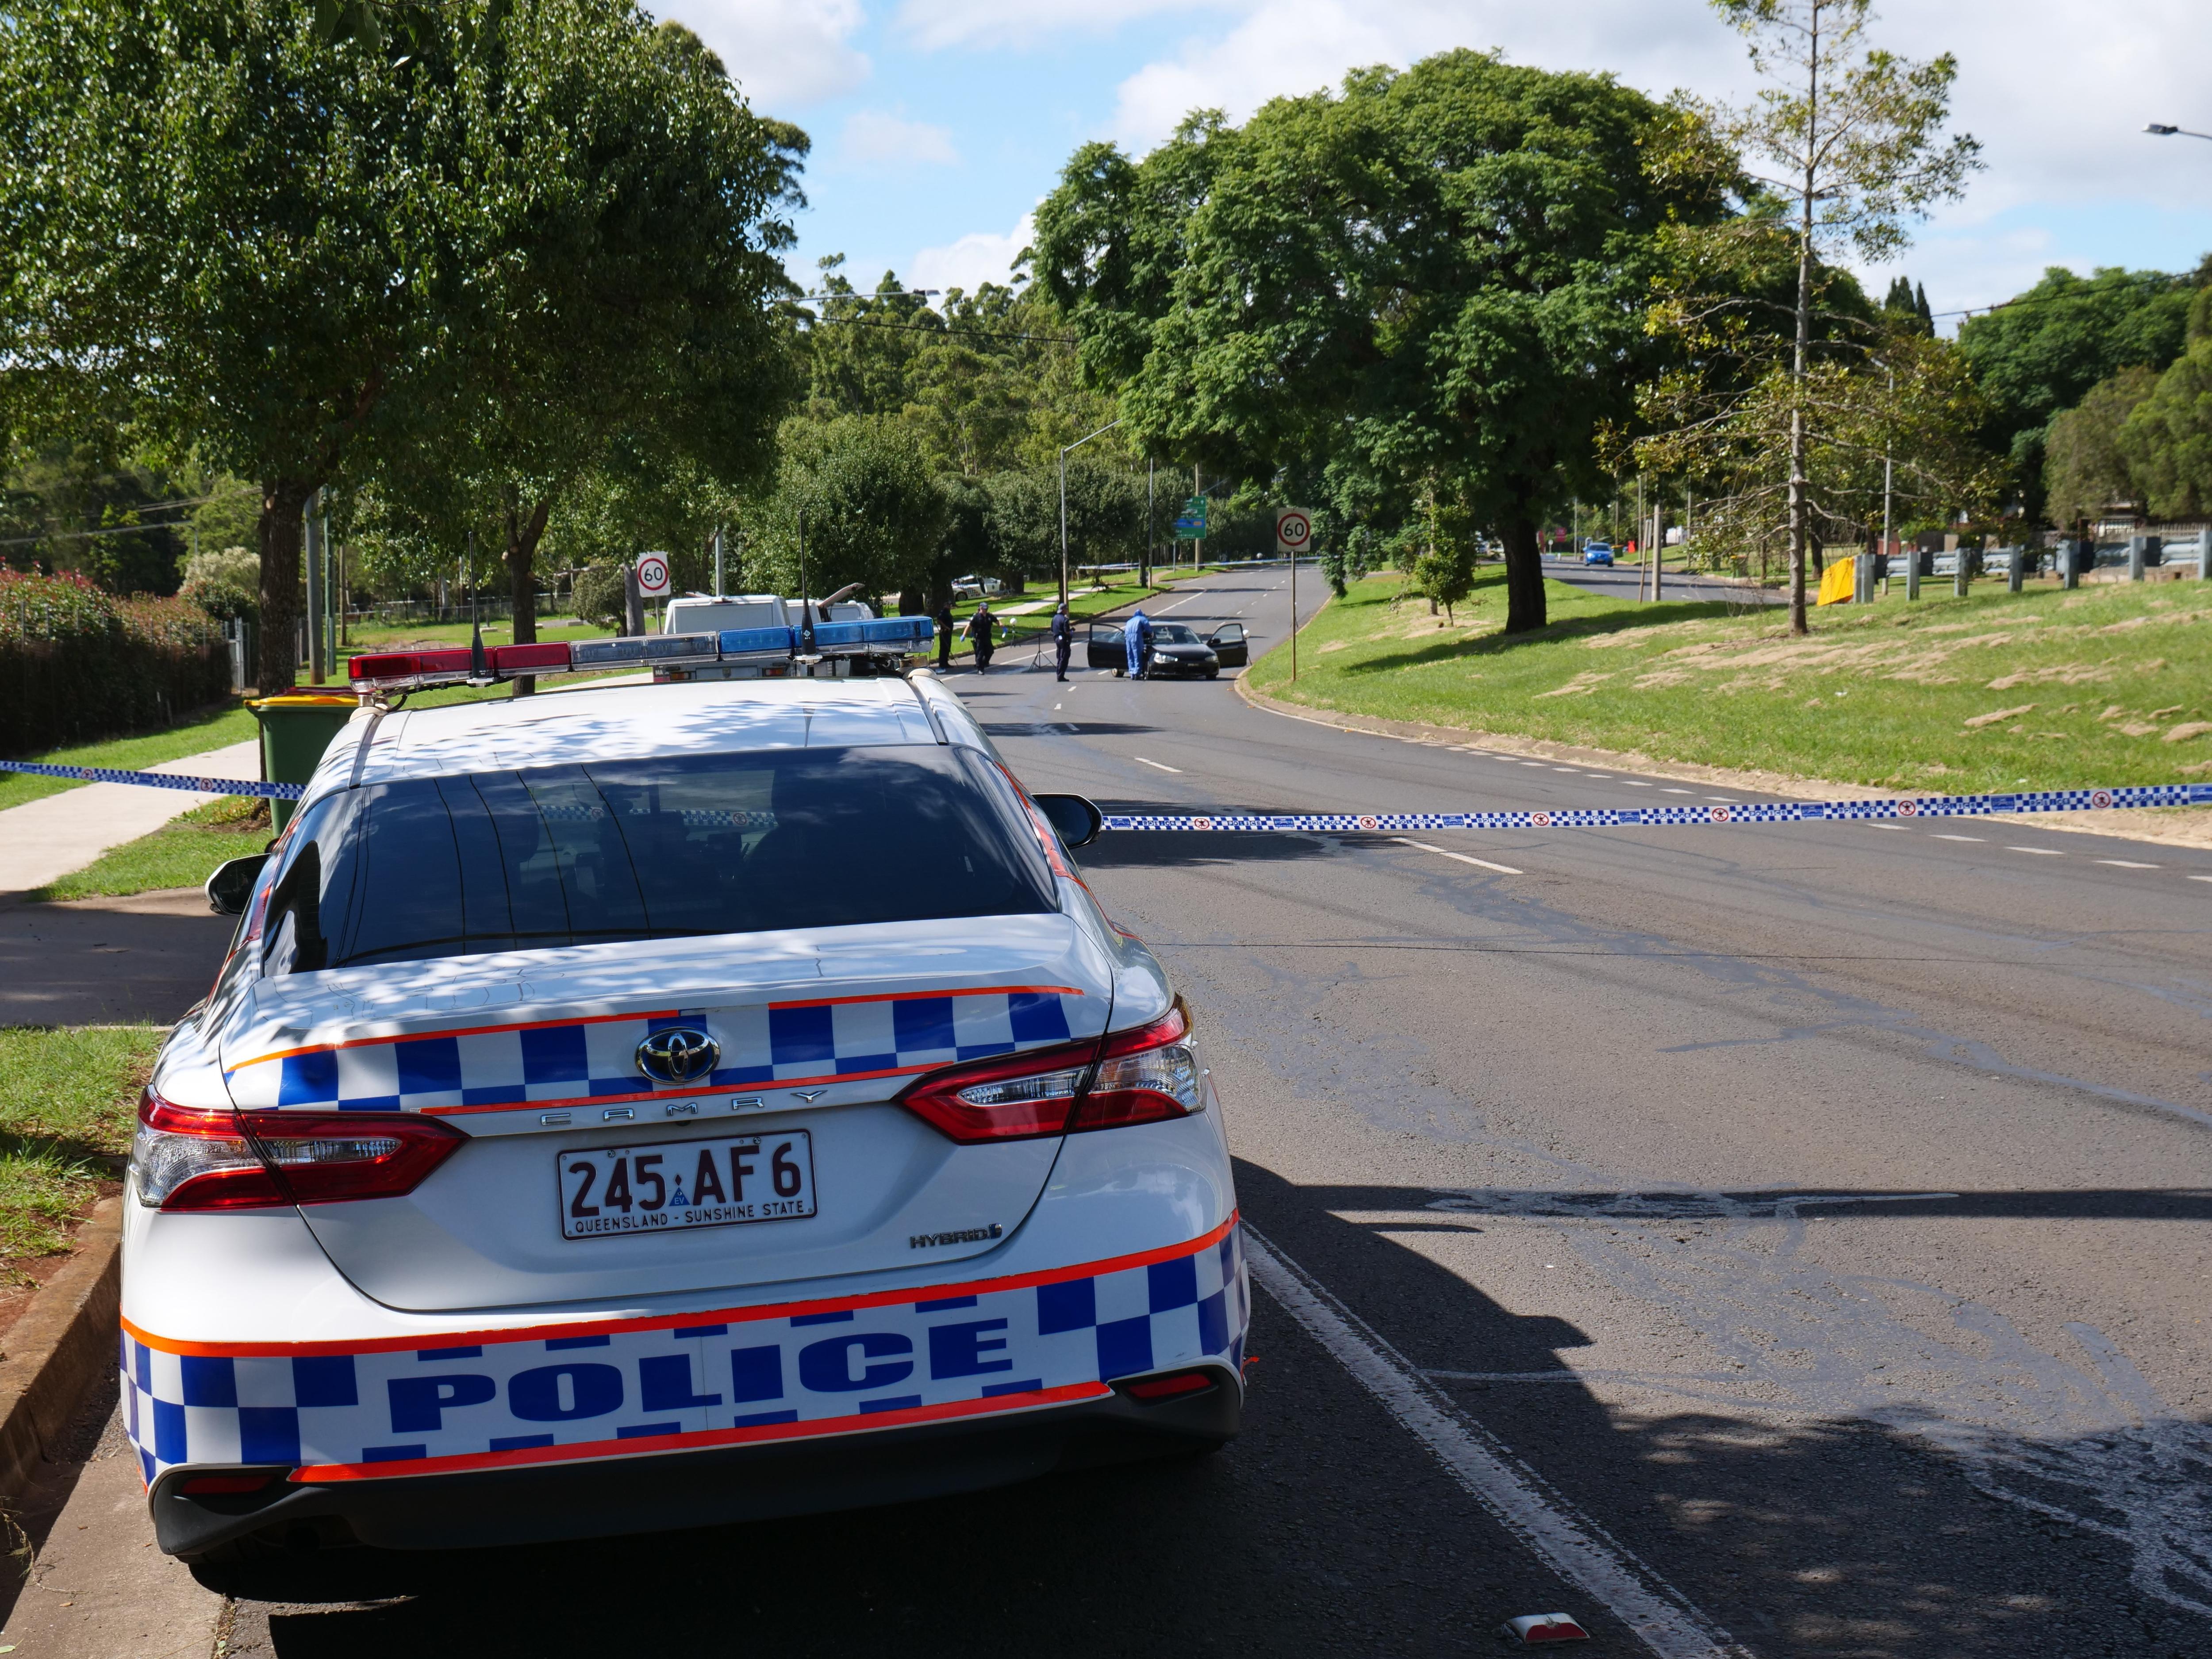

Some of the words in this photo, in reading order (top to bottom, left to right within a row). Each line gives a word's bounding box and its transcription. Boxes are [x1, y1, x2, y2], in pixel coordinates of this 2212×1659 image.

[1284, 522, 1304, 537] 60
[644, 567, 663, 582] 60
[541, 1090, 828, 1125] CAMRY
[569, 1154, 666, 1217] 245
[692, 1142, 801, 1206] AF6
[576, 1213, 668, 1233] QUEENSLAND
[685, 1206, 754, 1223] SUNSHINE
[763, 1200, 804, 1215] STATE
[910, 1227, 988, 1249] HYBRID
[388, 1317, 1013, 1434] POLICE
